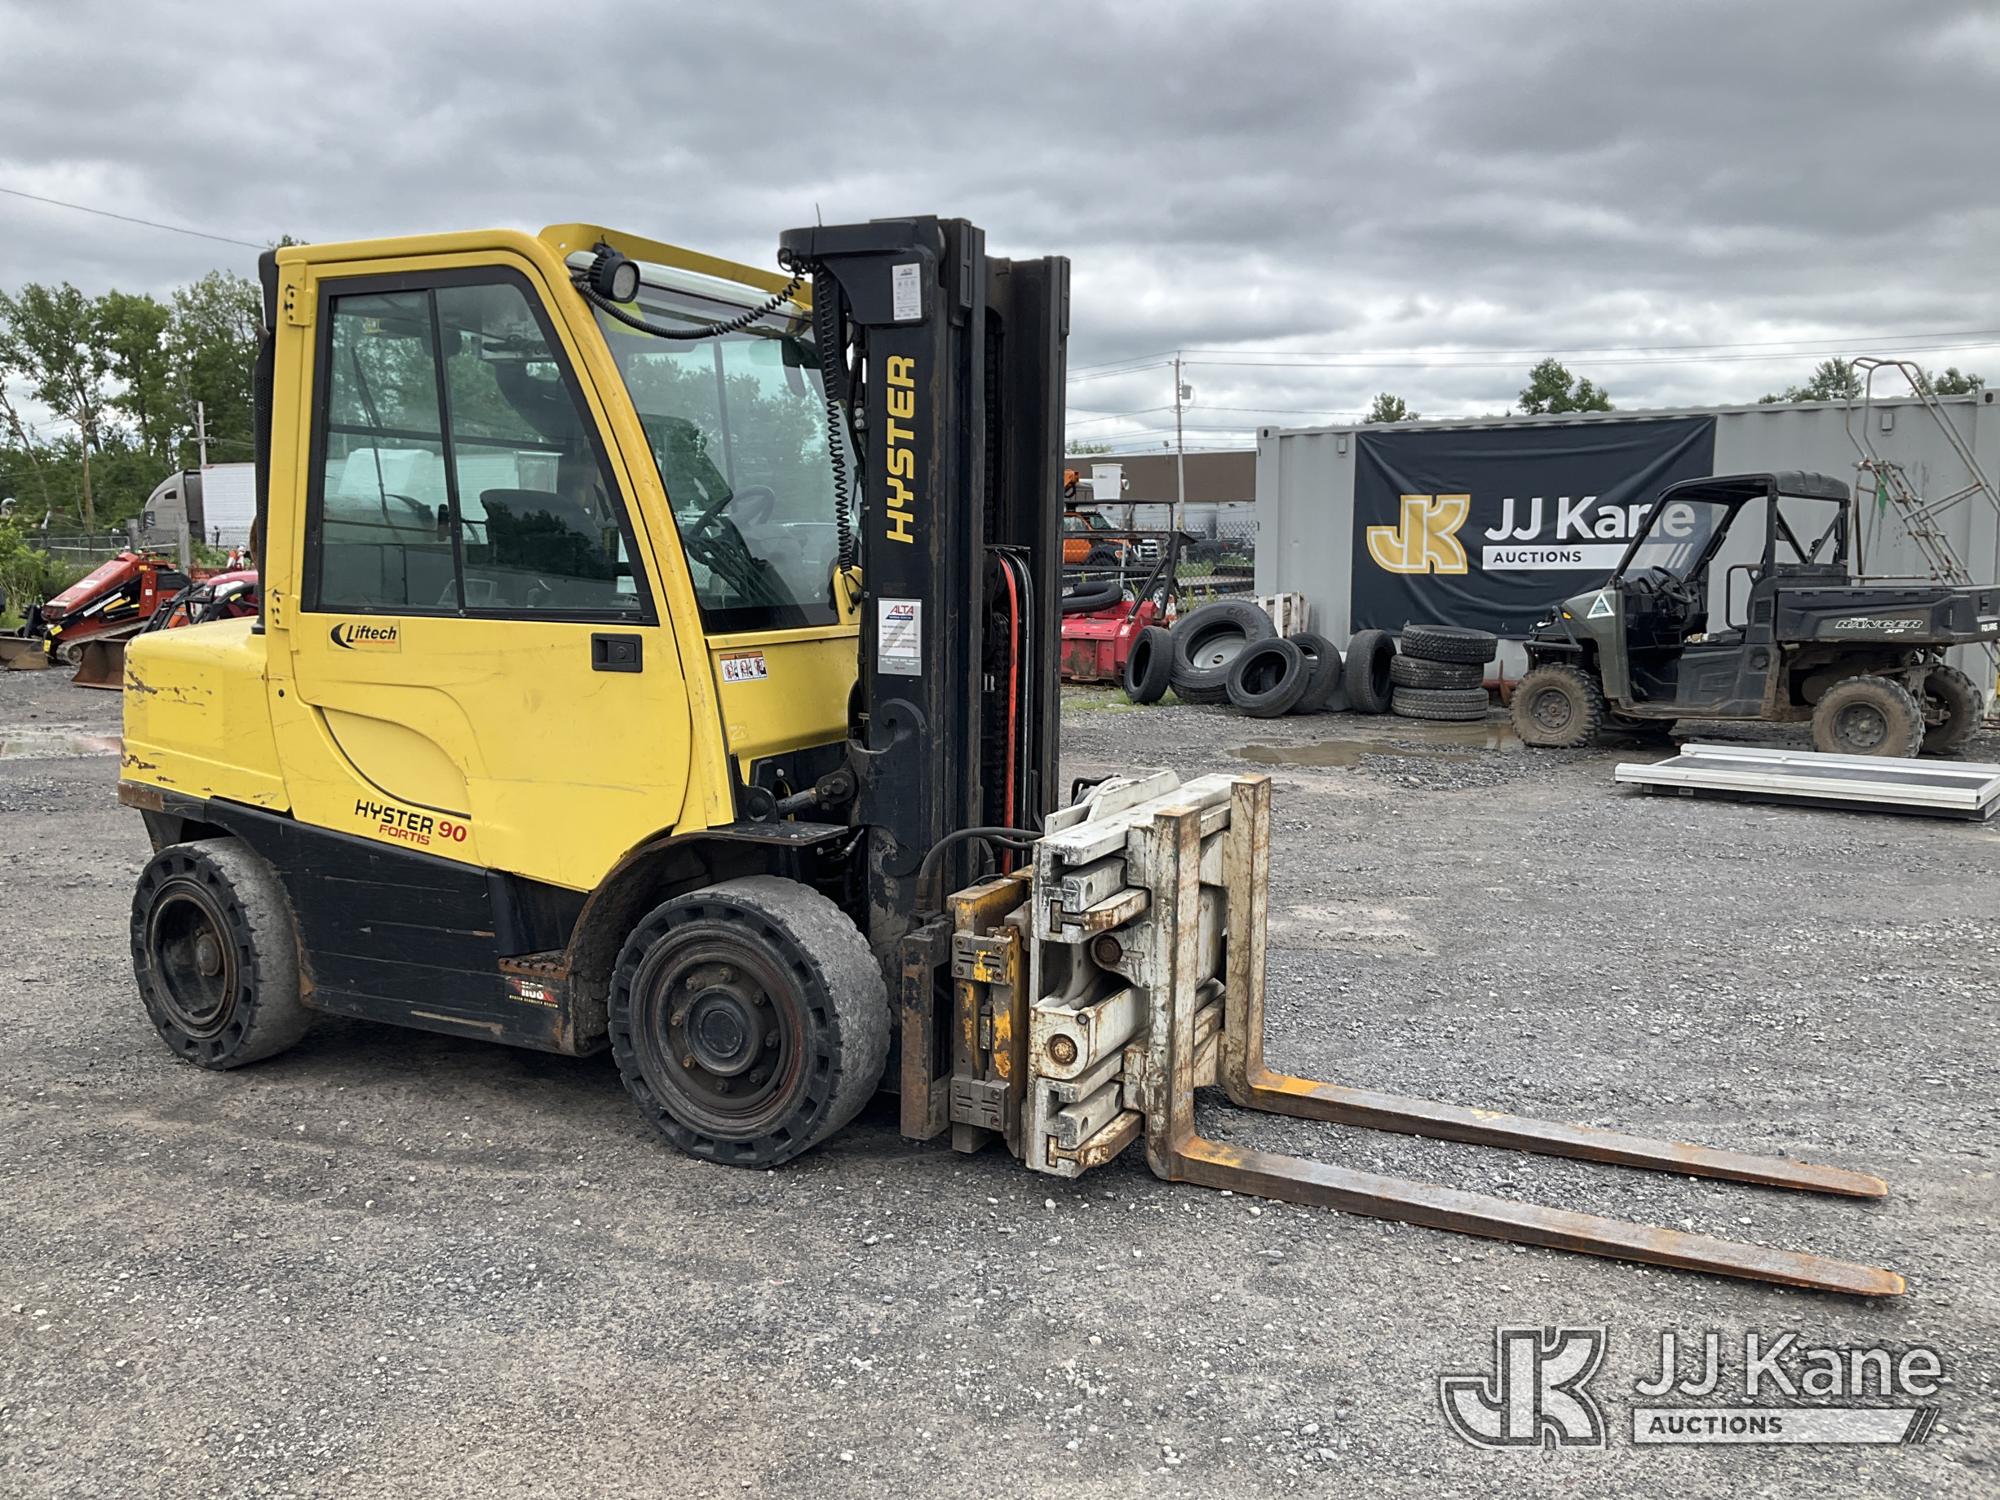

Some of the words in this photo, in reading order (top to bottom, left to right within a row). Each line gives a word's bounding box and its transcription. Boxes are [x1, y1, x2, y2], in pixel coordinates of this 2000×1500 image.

[887, 355, 915, 543] HYSTER
[1484, 498, 1543, 541] JJ
[1556, 496, 1696, 540] Kane
[1493, 551, 1582, 563] AUCTIONS
[890, 605, 914, 614] ALTA
[346, 625, 397, 643] Liftech
[355, 799, 434, 834] HYSTER
[438, 821, 467, 842] 90
[379, 824, 430, 845] FORTIS
